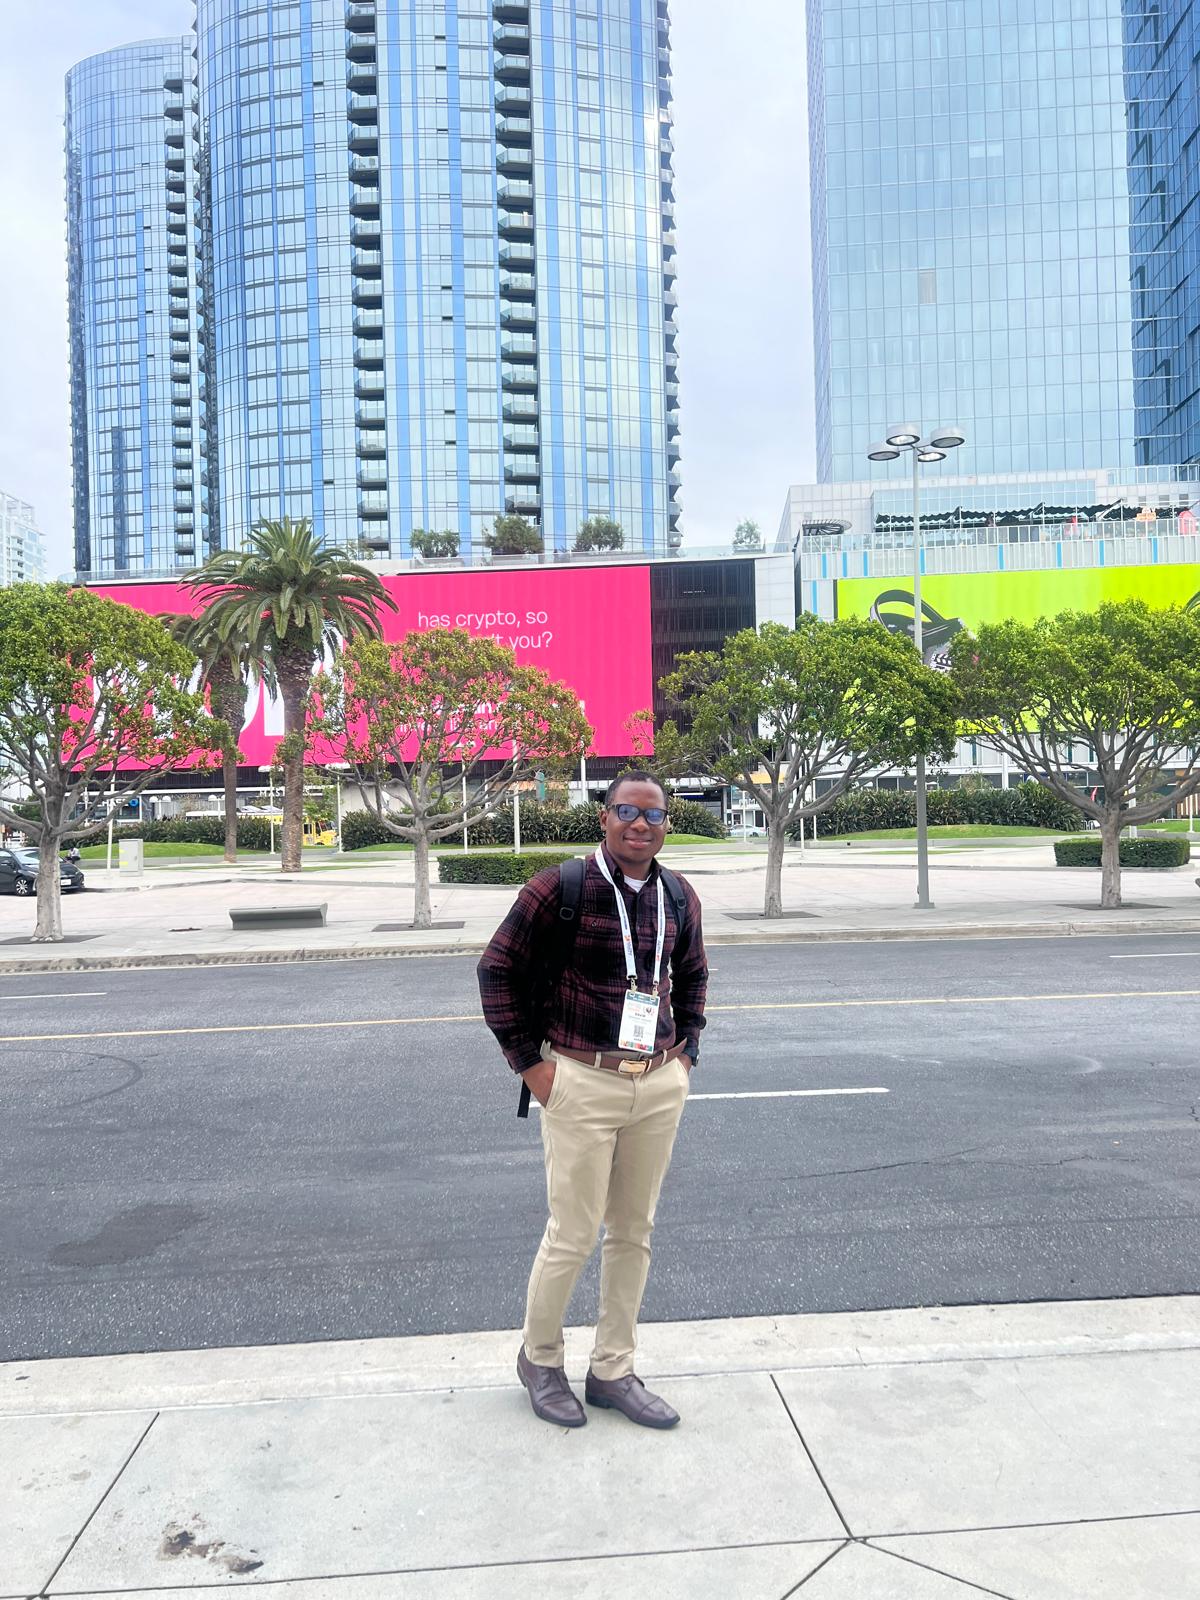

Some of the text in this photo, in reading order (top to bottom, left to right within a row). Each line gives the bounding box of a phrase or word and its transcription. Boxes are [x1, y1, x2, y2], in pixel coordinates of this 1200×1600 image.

[418, 610, 548, 630] has crypto, so
[508, 631, 553, 651] you?
